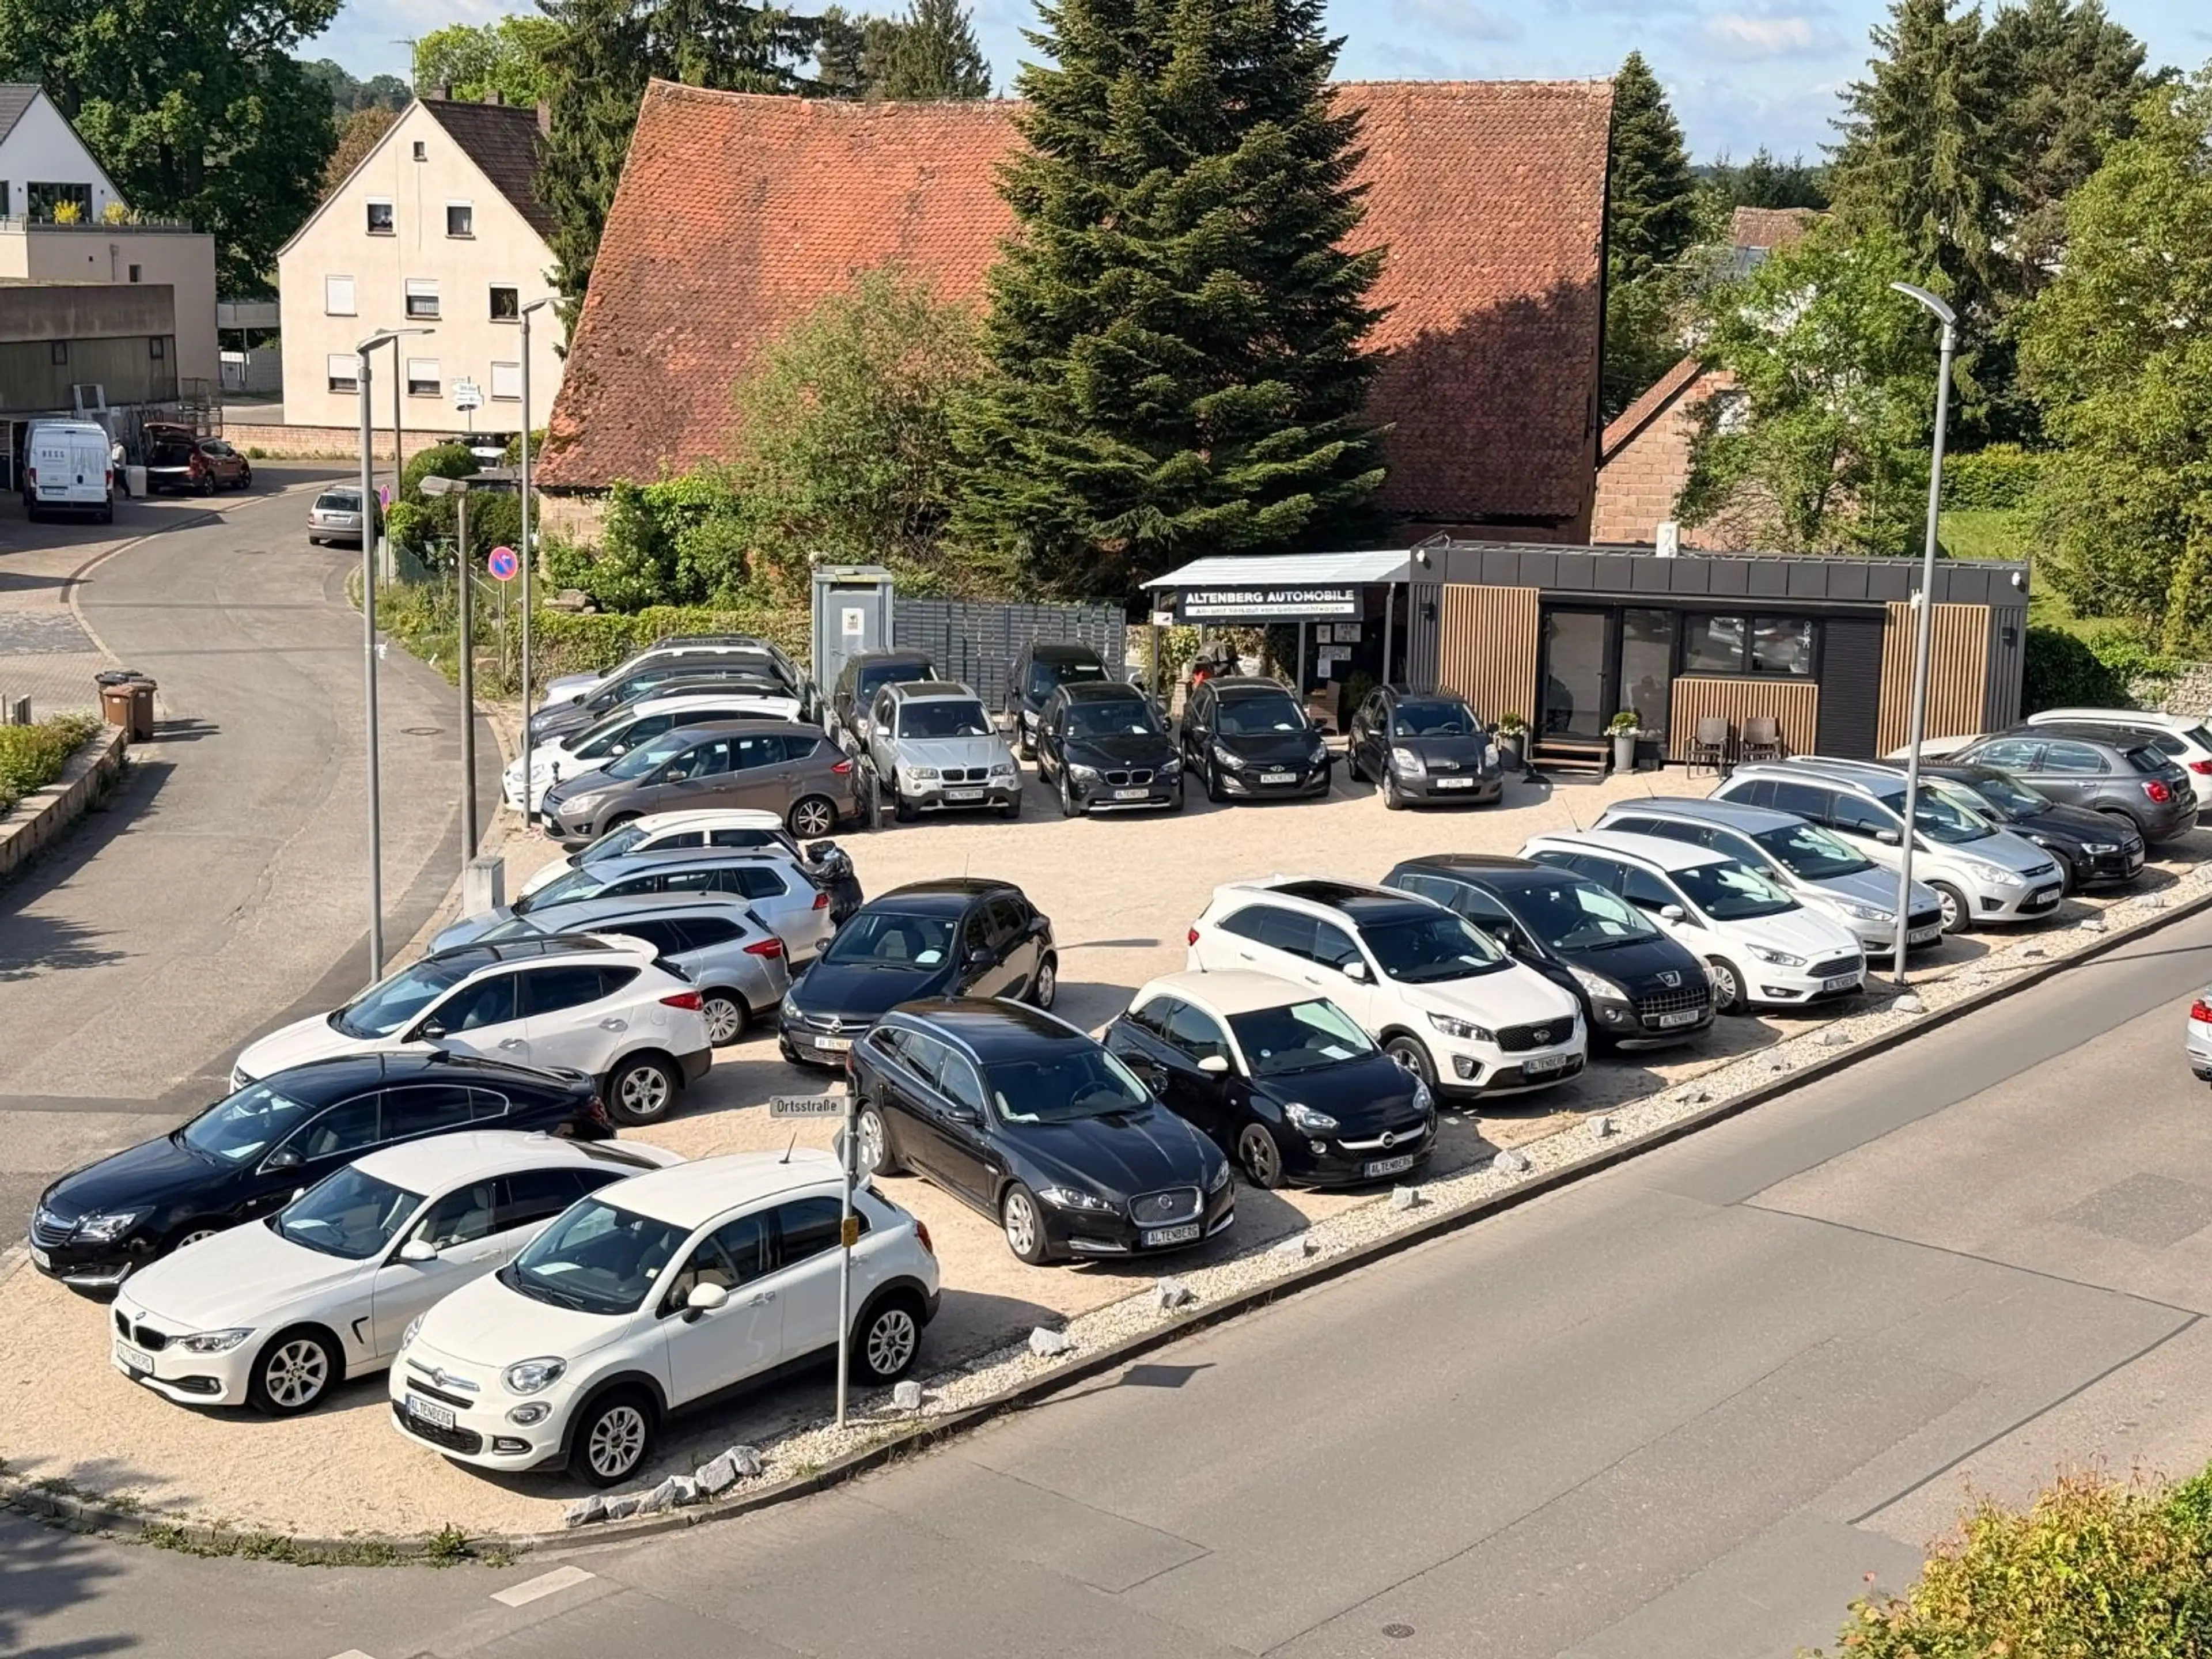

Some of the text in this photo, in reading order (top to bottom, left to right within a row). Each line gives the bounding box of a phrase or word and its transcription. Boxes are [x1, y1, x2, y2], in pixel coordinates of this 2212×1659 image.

[1185, 590, 1354, 604] ALTENBERG AUTOMOBILE
[1531, 1056, 1565, 1070] ALTENBERG
[778, 1099, 837, 1112] Ortsstraße
[1372, 1156, 1411, 1173] ALTENBERG
[1150, 1225, 1198, 1243] ALTENBERG
[119, 1344, 150, 1369] ALTENBERG
[411, 1399, 452, 1425] ALTENBERG
